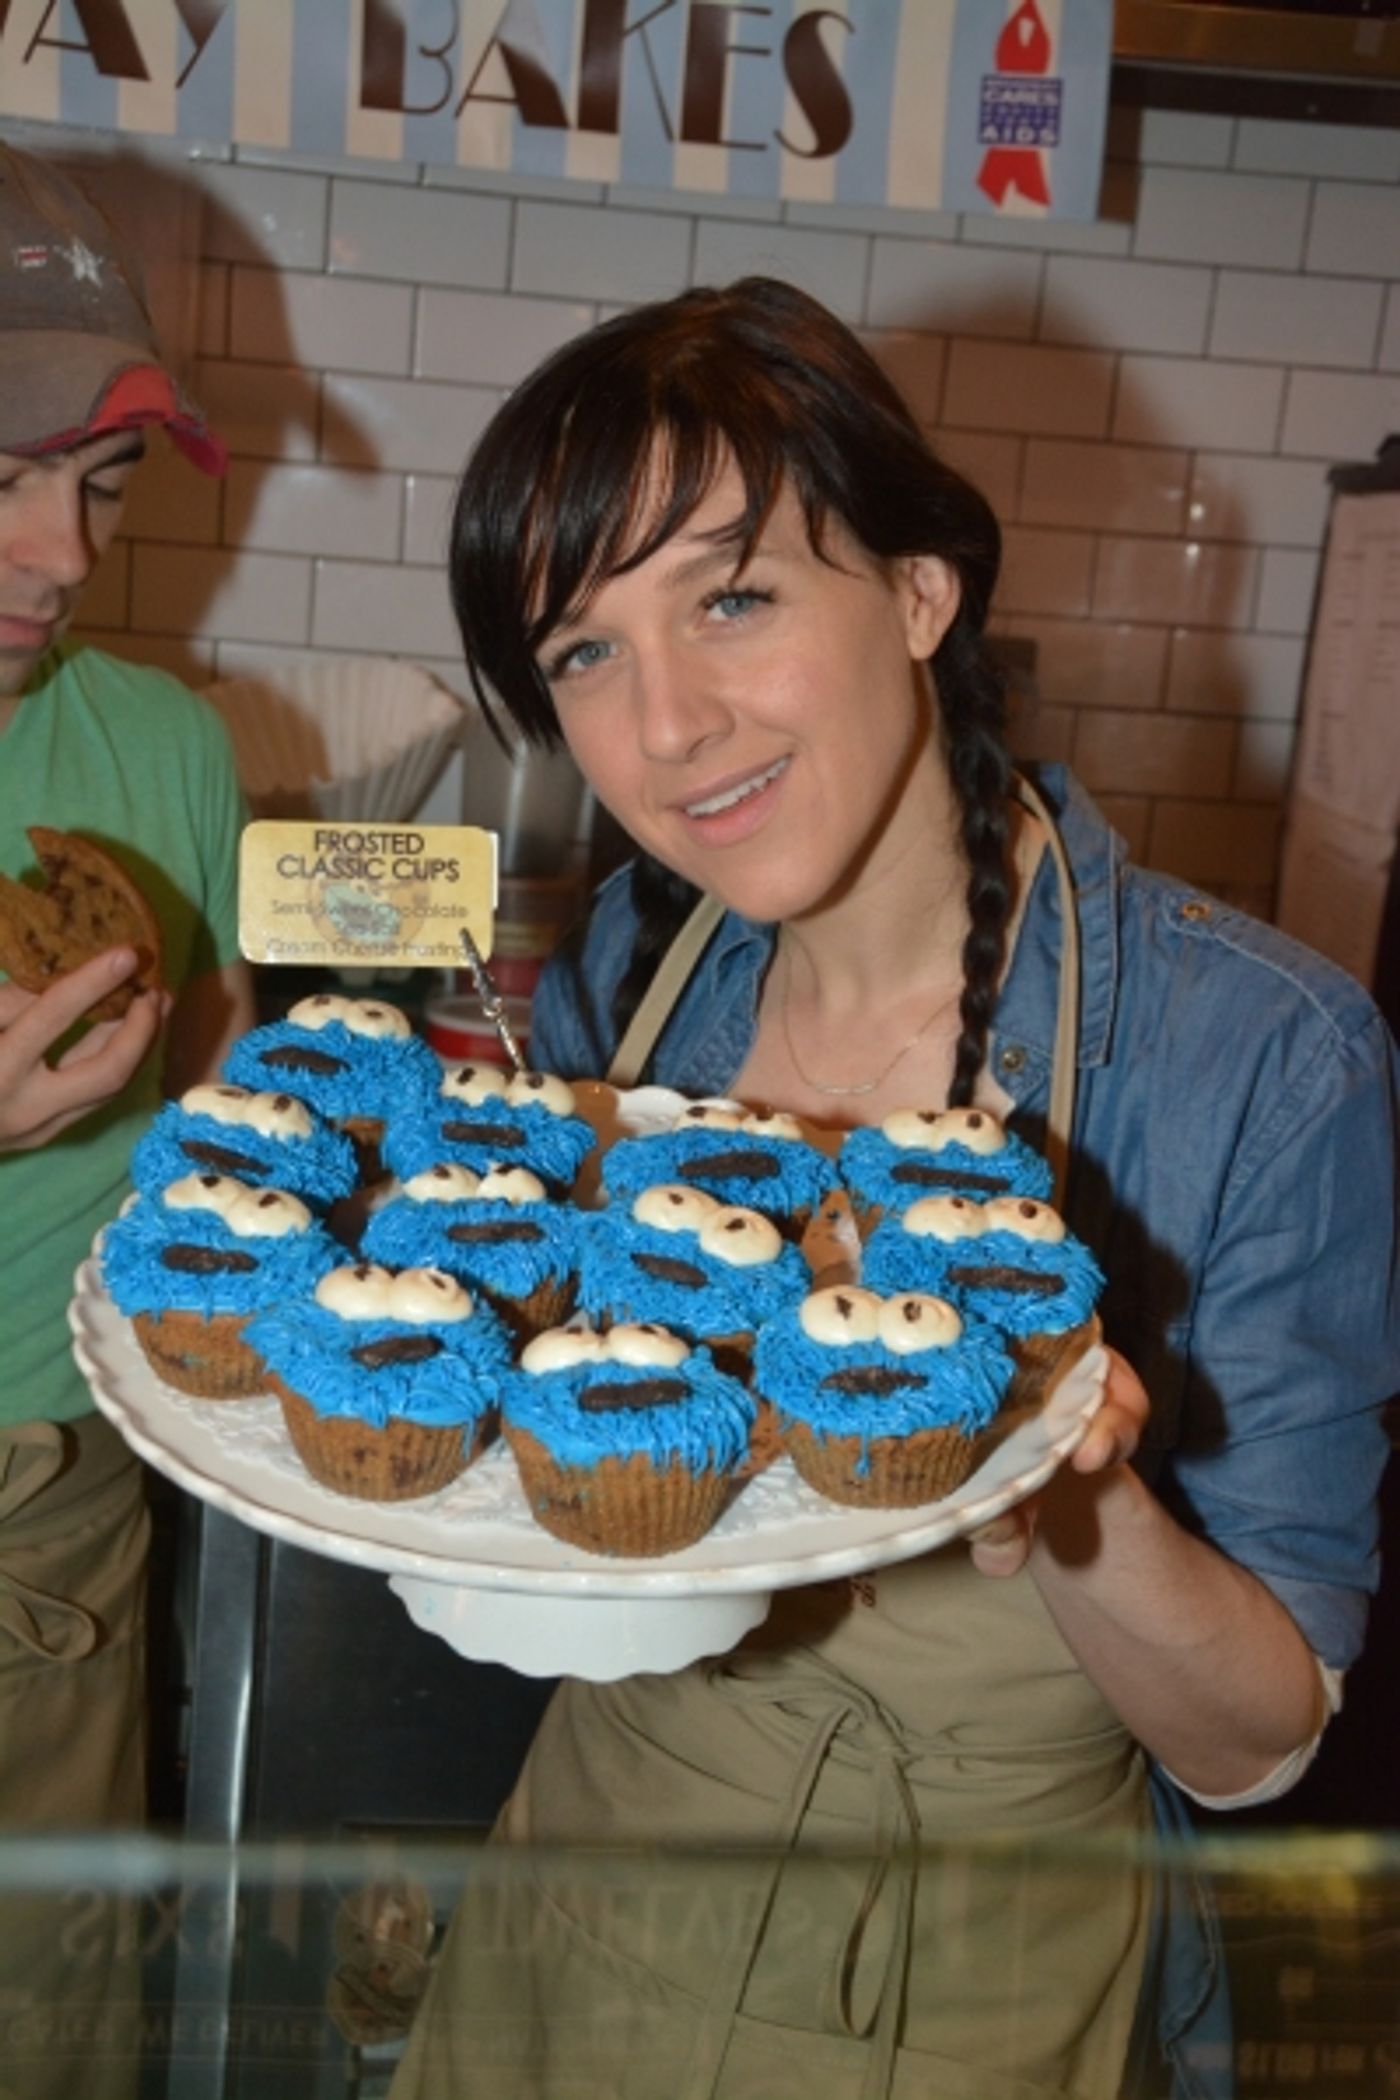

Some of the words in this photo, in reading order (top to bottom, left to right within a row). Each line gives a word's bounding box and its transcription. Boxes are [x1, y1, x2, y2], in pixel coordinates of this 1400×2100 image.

[0, 0, 232, 88] AY
[359, 0, 856, 159] BAKES
[314, 829, 425, 855] FROSTED
[276, 854, 386, 880] CLASSIC
[391, 857, 461, 883] CUPS
